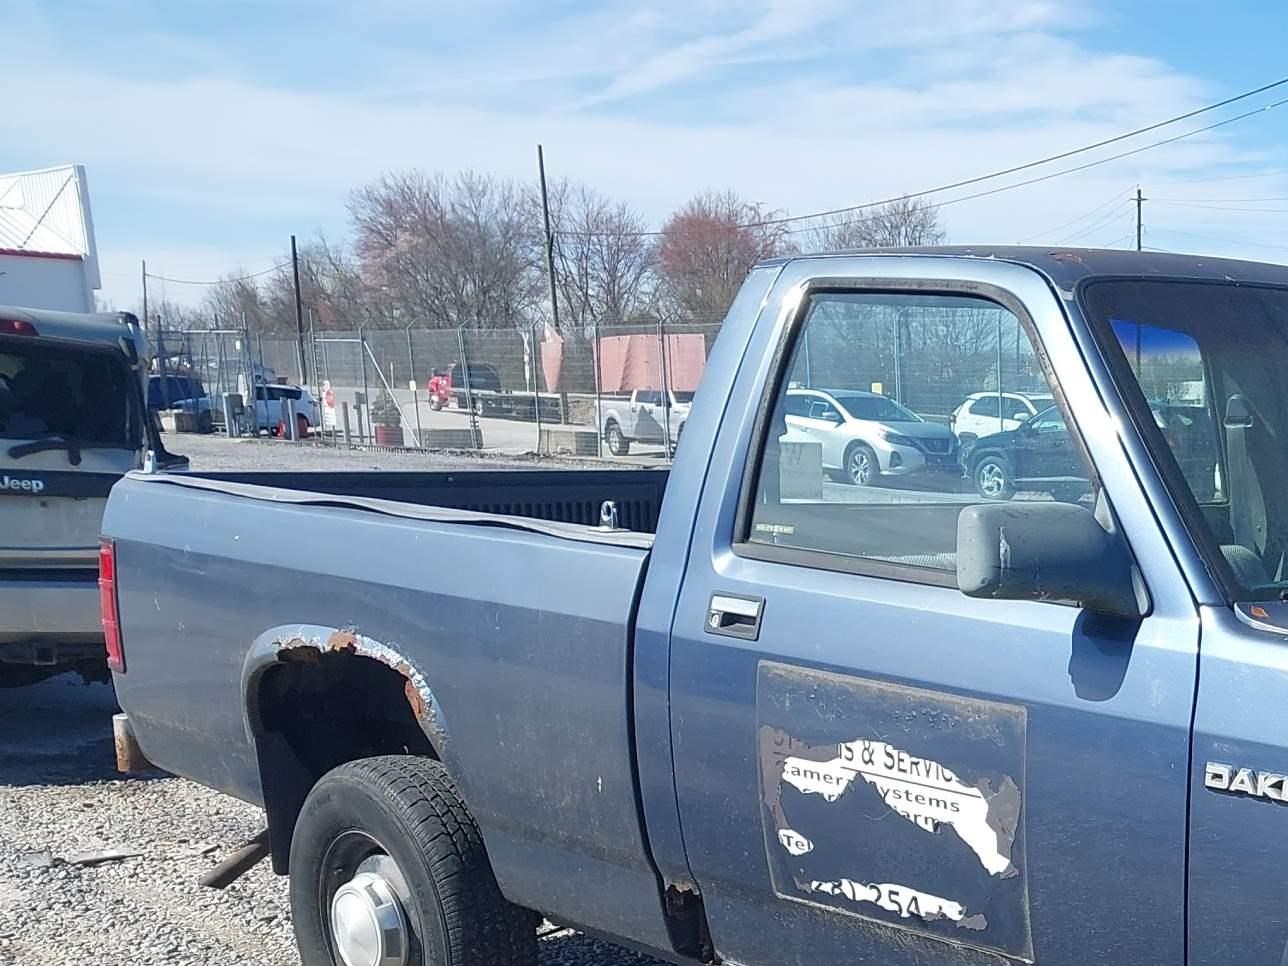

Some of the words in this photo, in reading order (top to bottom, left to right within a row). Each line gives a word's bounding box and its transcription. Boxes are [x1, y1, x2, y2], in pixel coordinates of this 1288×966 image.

[0, 475, 44, 493] Jeep
[884, 744, 961, 783] SERVIC
[868, 781, 961, 813] ystems
